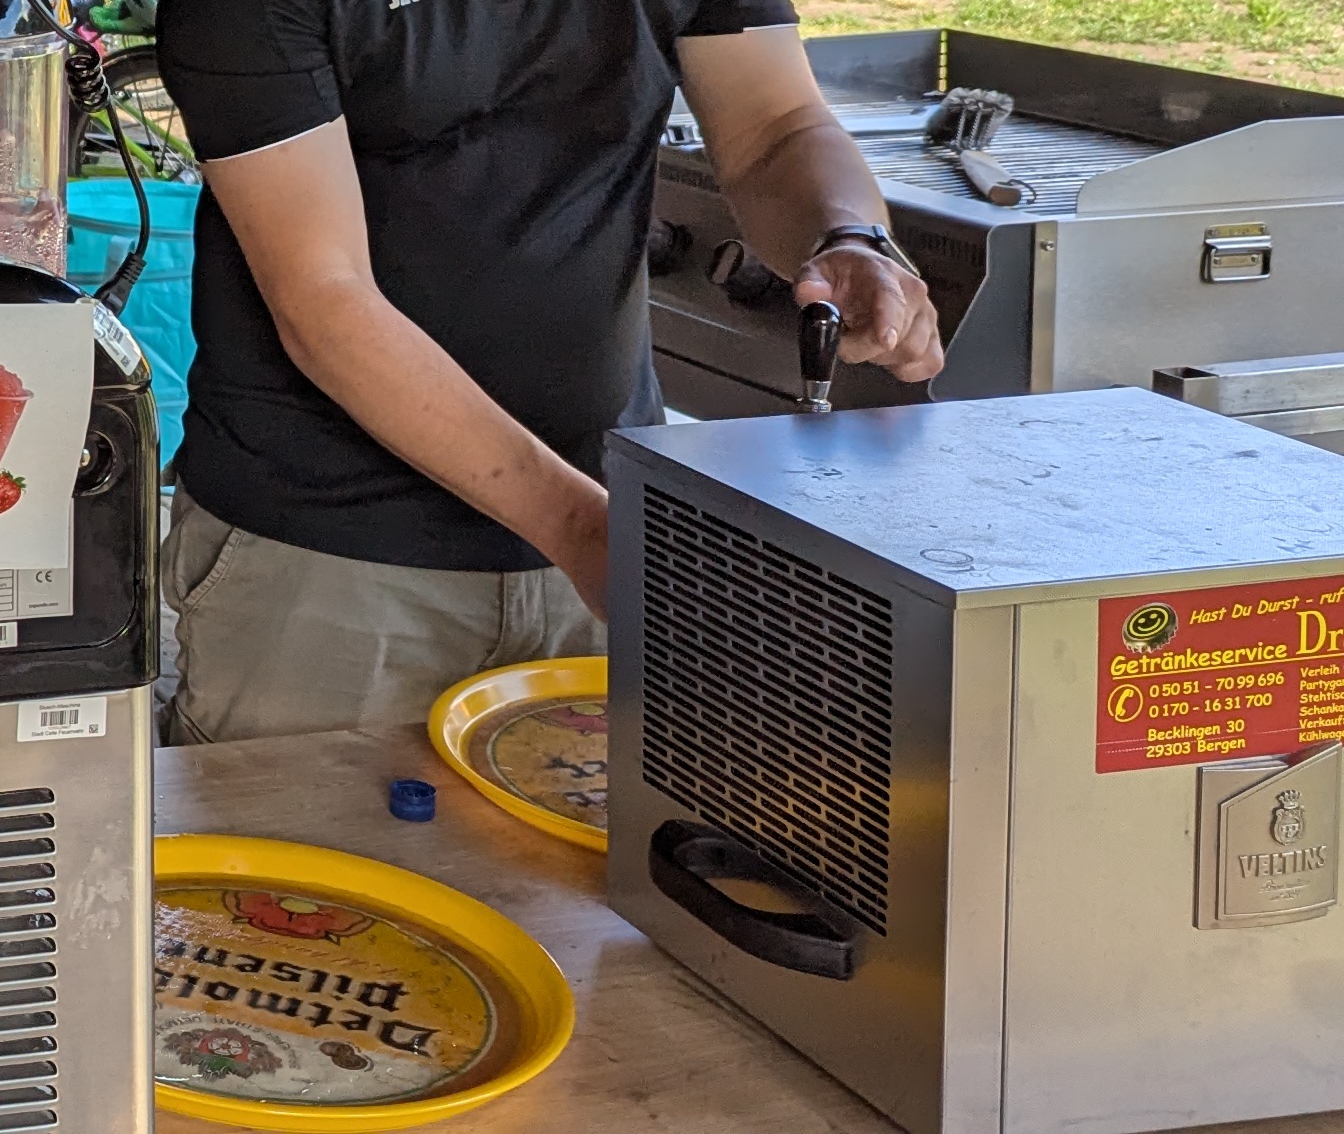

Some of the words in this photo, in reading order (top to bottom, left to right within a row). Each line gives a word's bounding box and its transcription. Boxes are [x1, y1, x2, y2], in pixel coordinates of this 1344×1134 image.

[1190, 608, 1225, 625] Hast
[1231, 604, 1252, 619] Du
[1257, 595, 1300, 615] Durst
[1111, 642, 1287, 676] Getränkeservice
[1300, 664, 1340, 678] Verleih
[1300, 679, 1344, 691] Partyga
[1148, 723, 1221, 742] Becklingen
[1226, 719, 1245, 733] 30
[1299, 715, 1344, 729] Verkauf
[1146, 742, 1191, 758] 29303
[1197, 737, 1246, 754] Bergen
[1238, 846, 1327, 879] VELTINS
